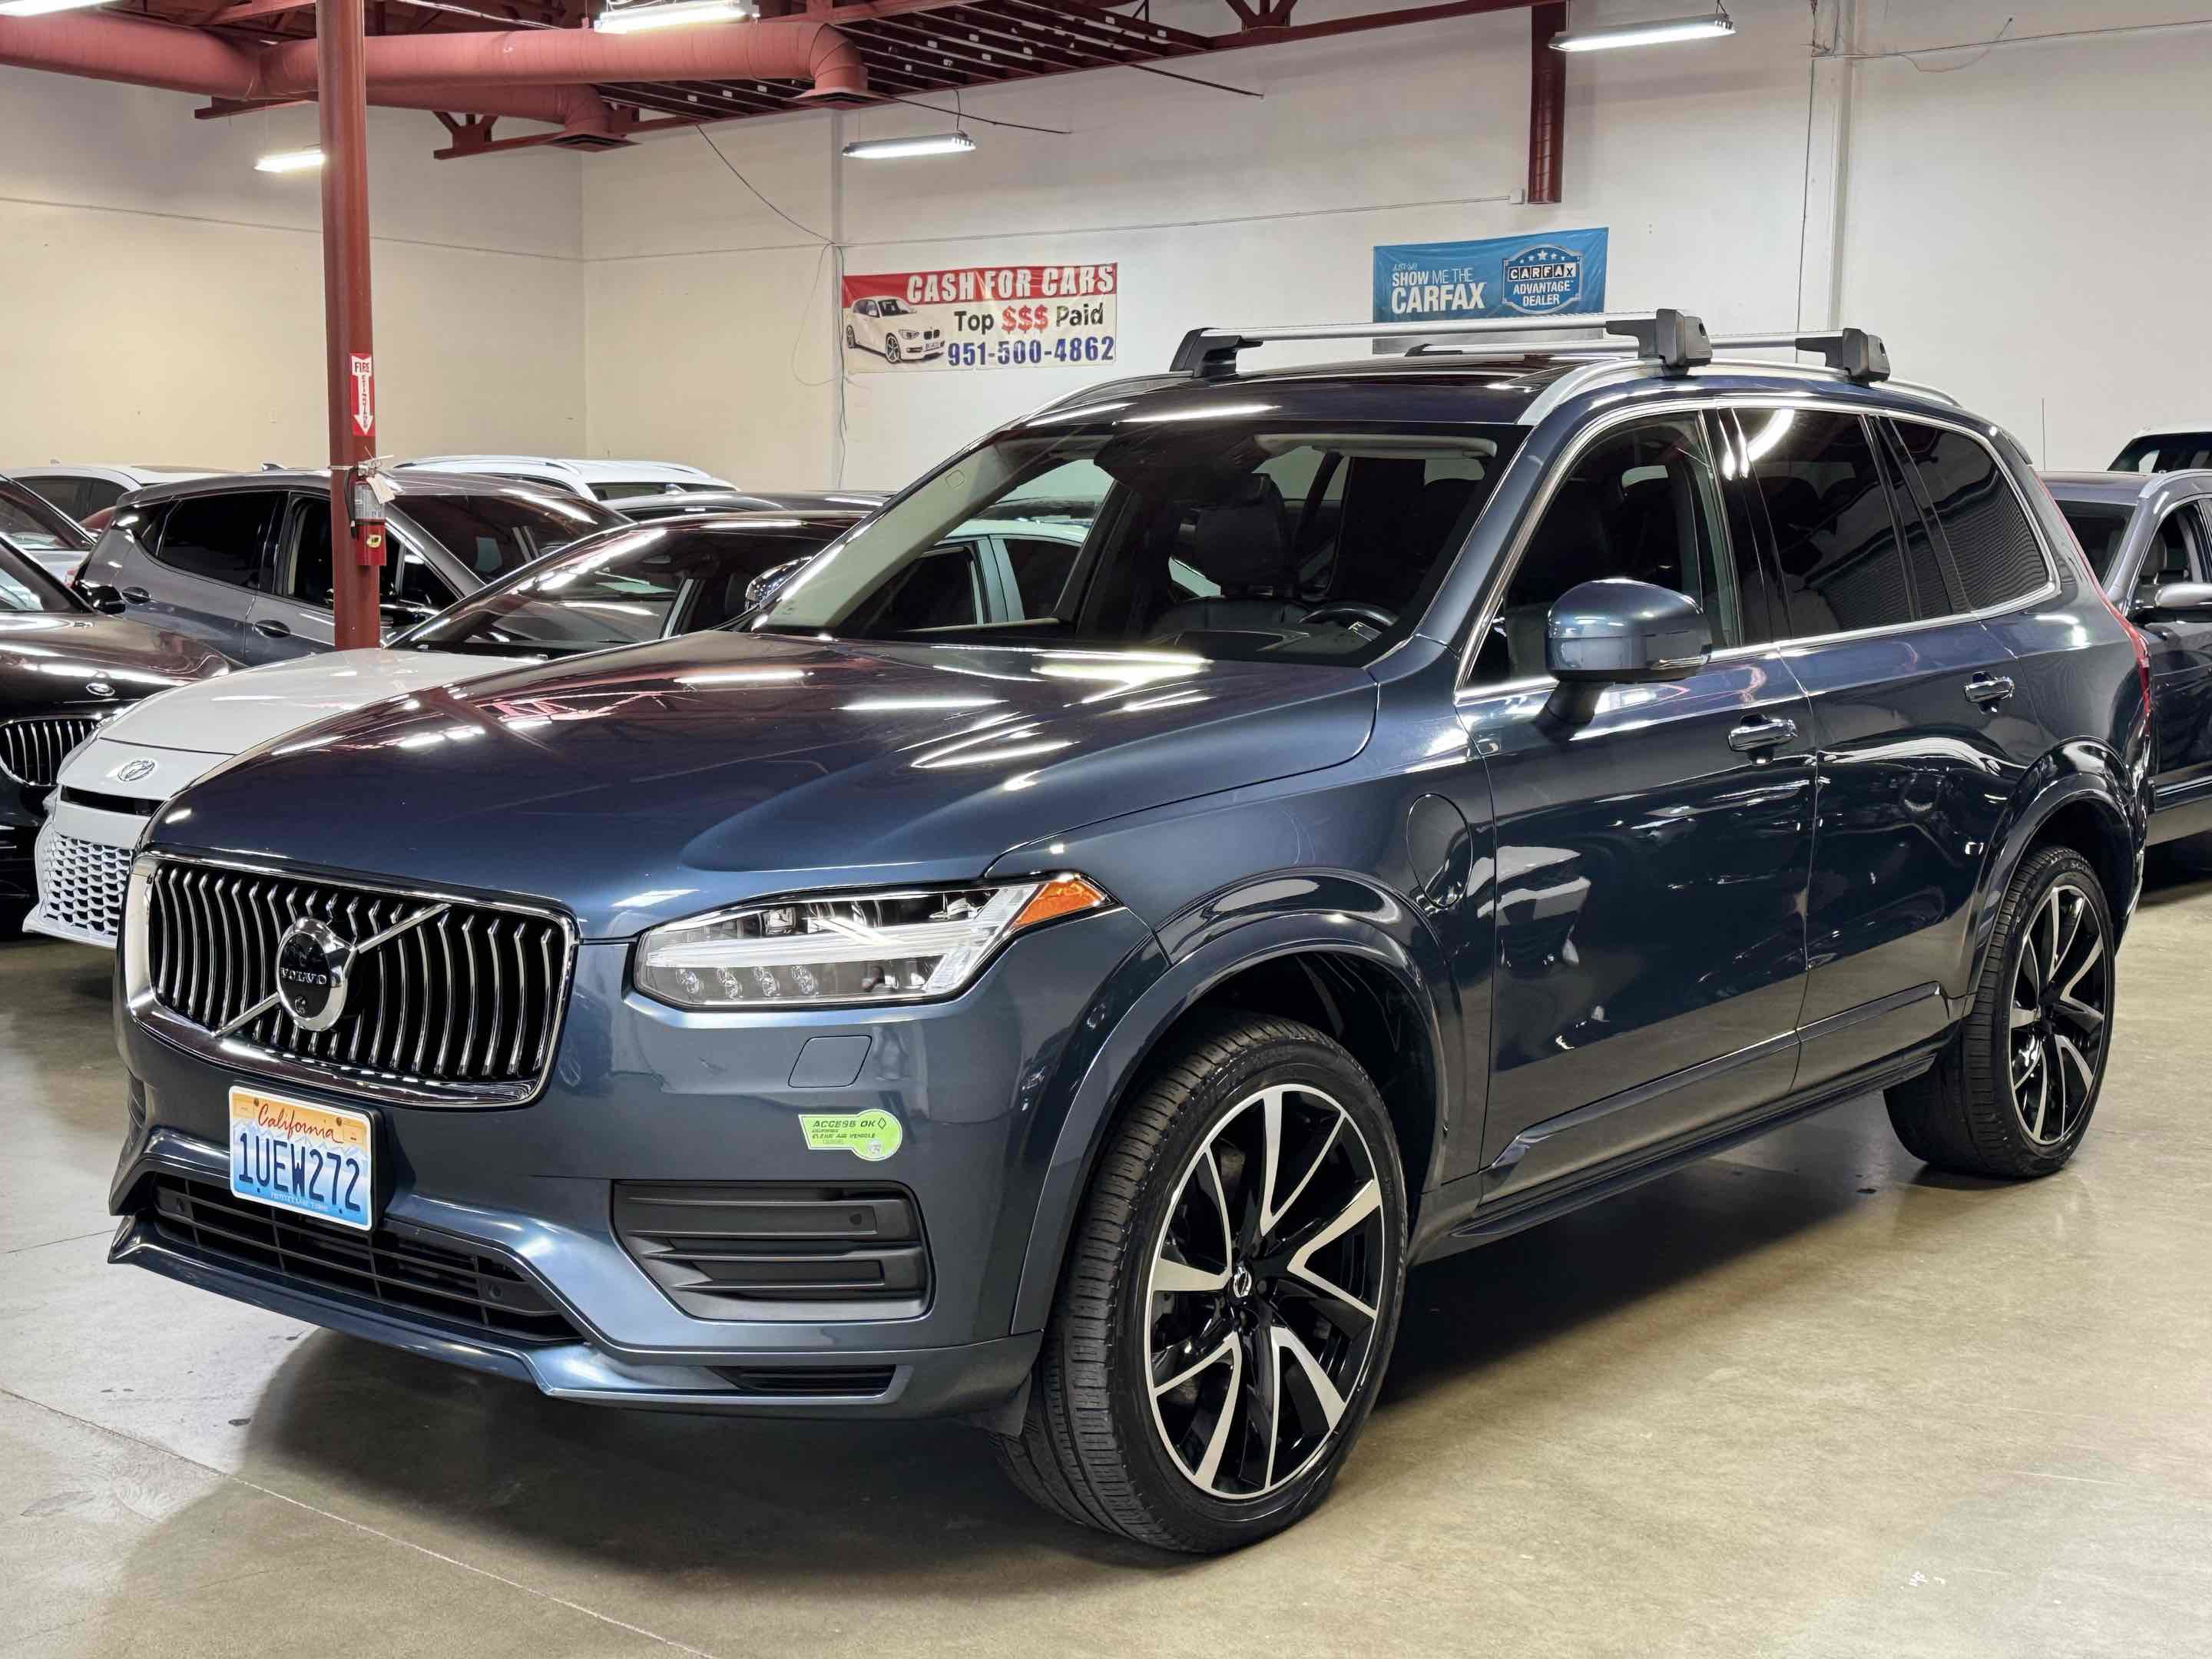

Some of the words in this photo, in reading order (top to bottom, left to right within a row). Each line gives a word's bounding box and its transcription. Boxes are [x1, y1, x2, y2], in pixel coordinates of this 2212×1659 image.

[906, 271, 975, 304] CASH
[984, 269, 1031, 299] FOR
[1041, 265, 1114, 296] CARS
[1392, 270, 1429, 287] SHOW
[1432, 269, 1449, 284] ME
[1452, 267, 1474, 283] THE
[1510, 263, 1574, 280] CARFAX
[1391, 281, 1487, 314] CARFAX
[1513, 280, 1571, 296] ADVANTAGE
[1522, 293, 1561, 307] DEALER
[953, 310, 995, 335] Top
[1002, 304, 1049, 334] $$$
[1056, 302, 1104, 327] Paid
[947, 336, 1114, 366] 951-500-4862
[280, 966, 327, 985] VOLVO
[257, 1103, 344, 1144] California
[239, 1132, 360, 1212] 1UEW272
